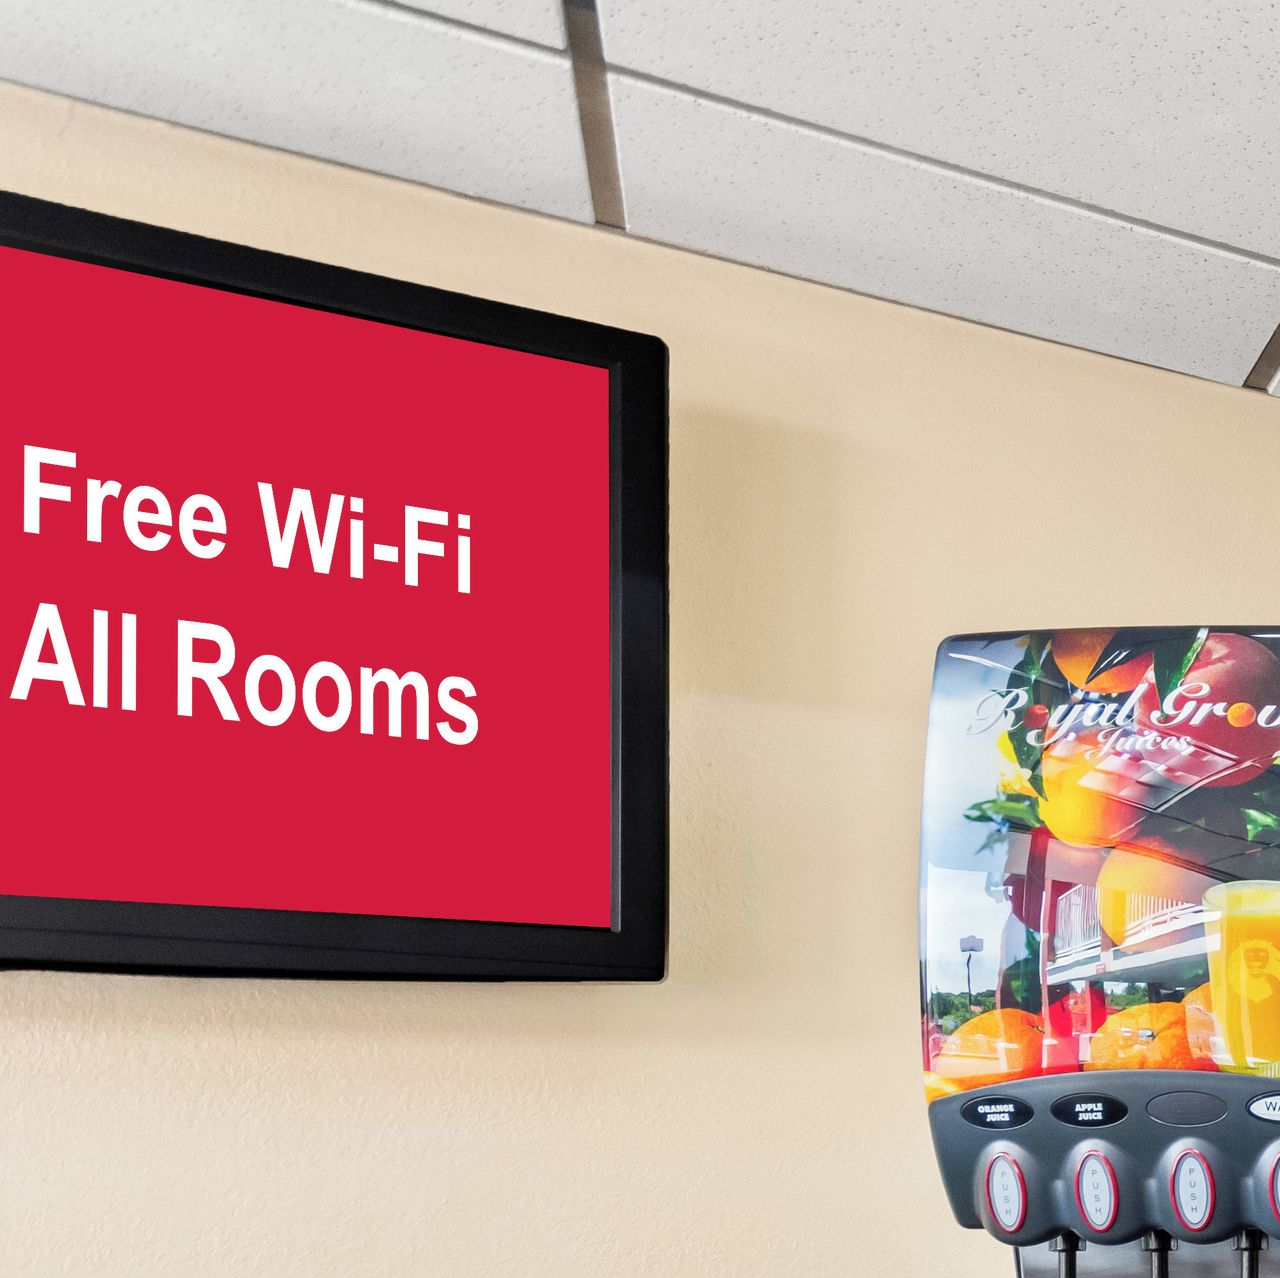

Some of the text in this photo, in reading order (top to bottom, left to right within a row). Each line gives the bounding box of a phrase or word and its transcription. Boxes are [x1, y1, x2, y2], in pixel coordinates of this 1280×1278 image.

[23, 444, 471, 593] Free Wi-Fi
[10, 602, 479, 746] All Rooms
[1084, 727, 1193, 760] Juices
[977, 1104, 1015, 1114] ORANGE
[986, 1112, 1010, 1122] JUICE
[1074, 1102, 1104, 1112] APPLE
[1077, 1111, 1104, 1121] JUICE
[1000, 1170, 1013, 1217] PUSH
[1090, 1168, 1103, 1215] PUSH
[1187, 1166, 1200, 1214] PUSH
